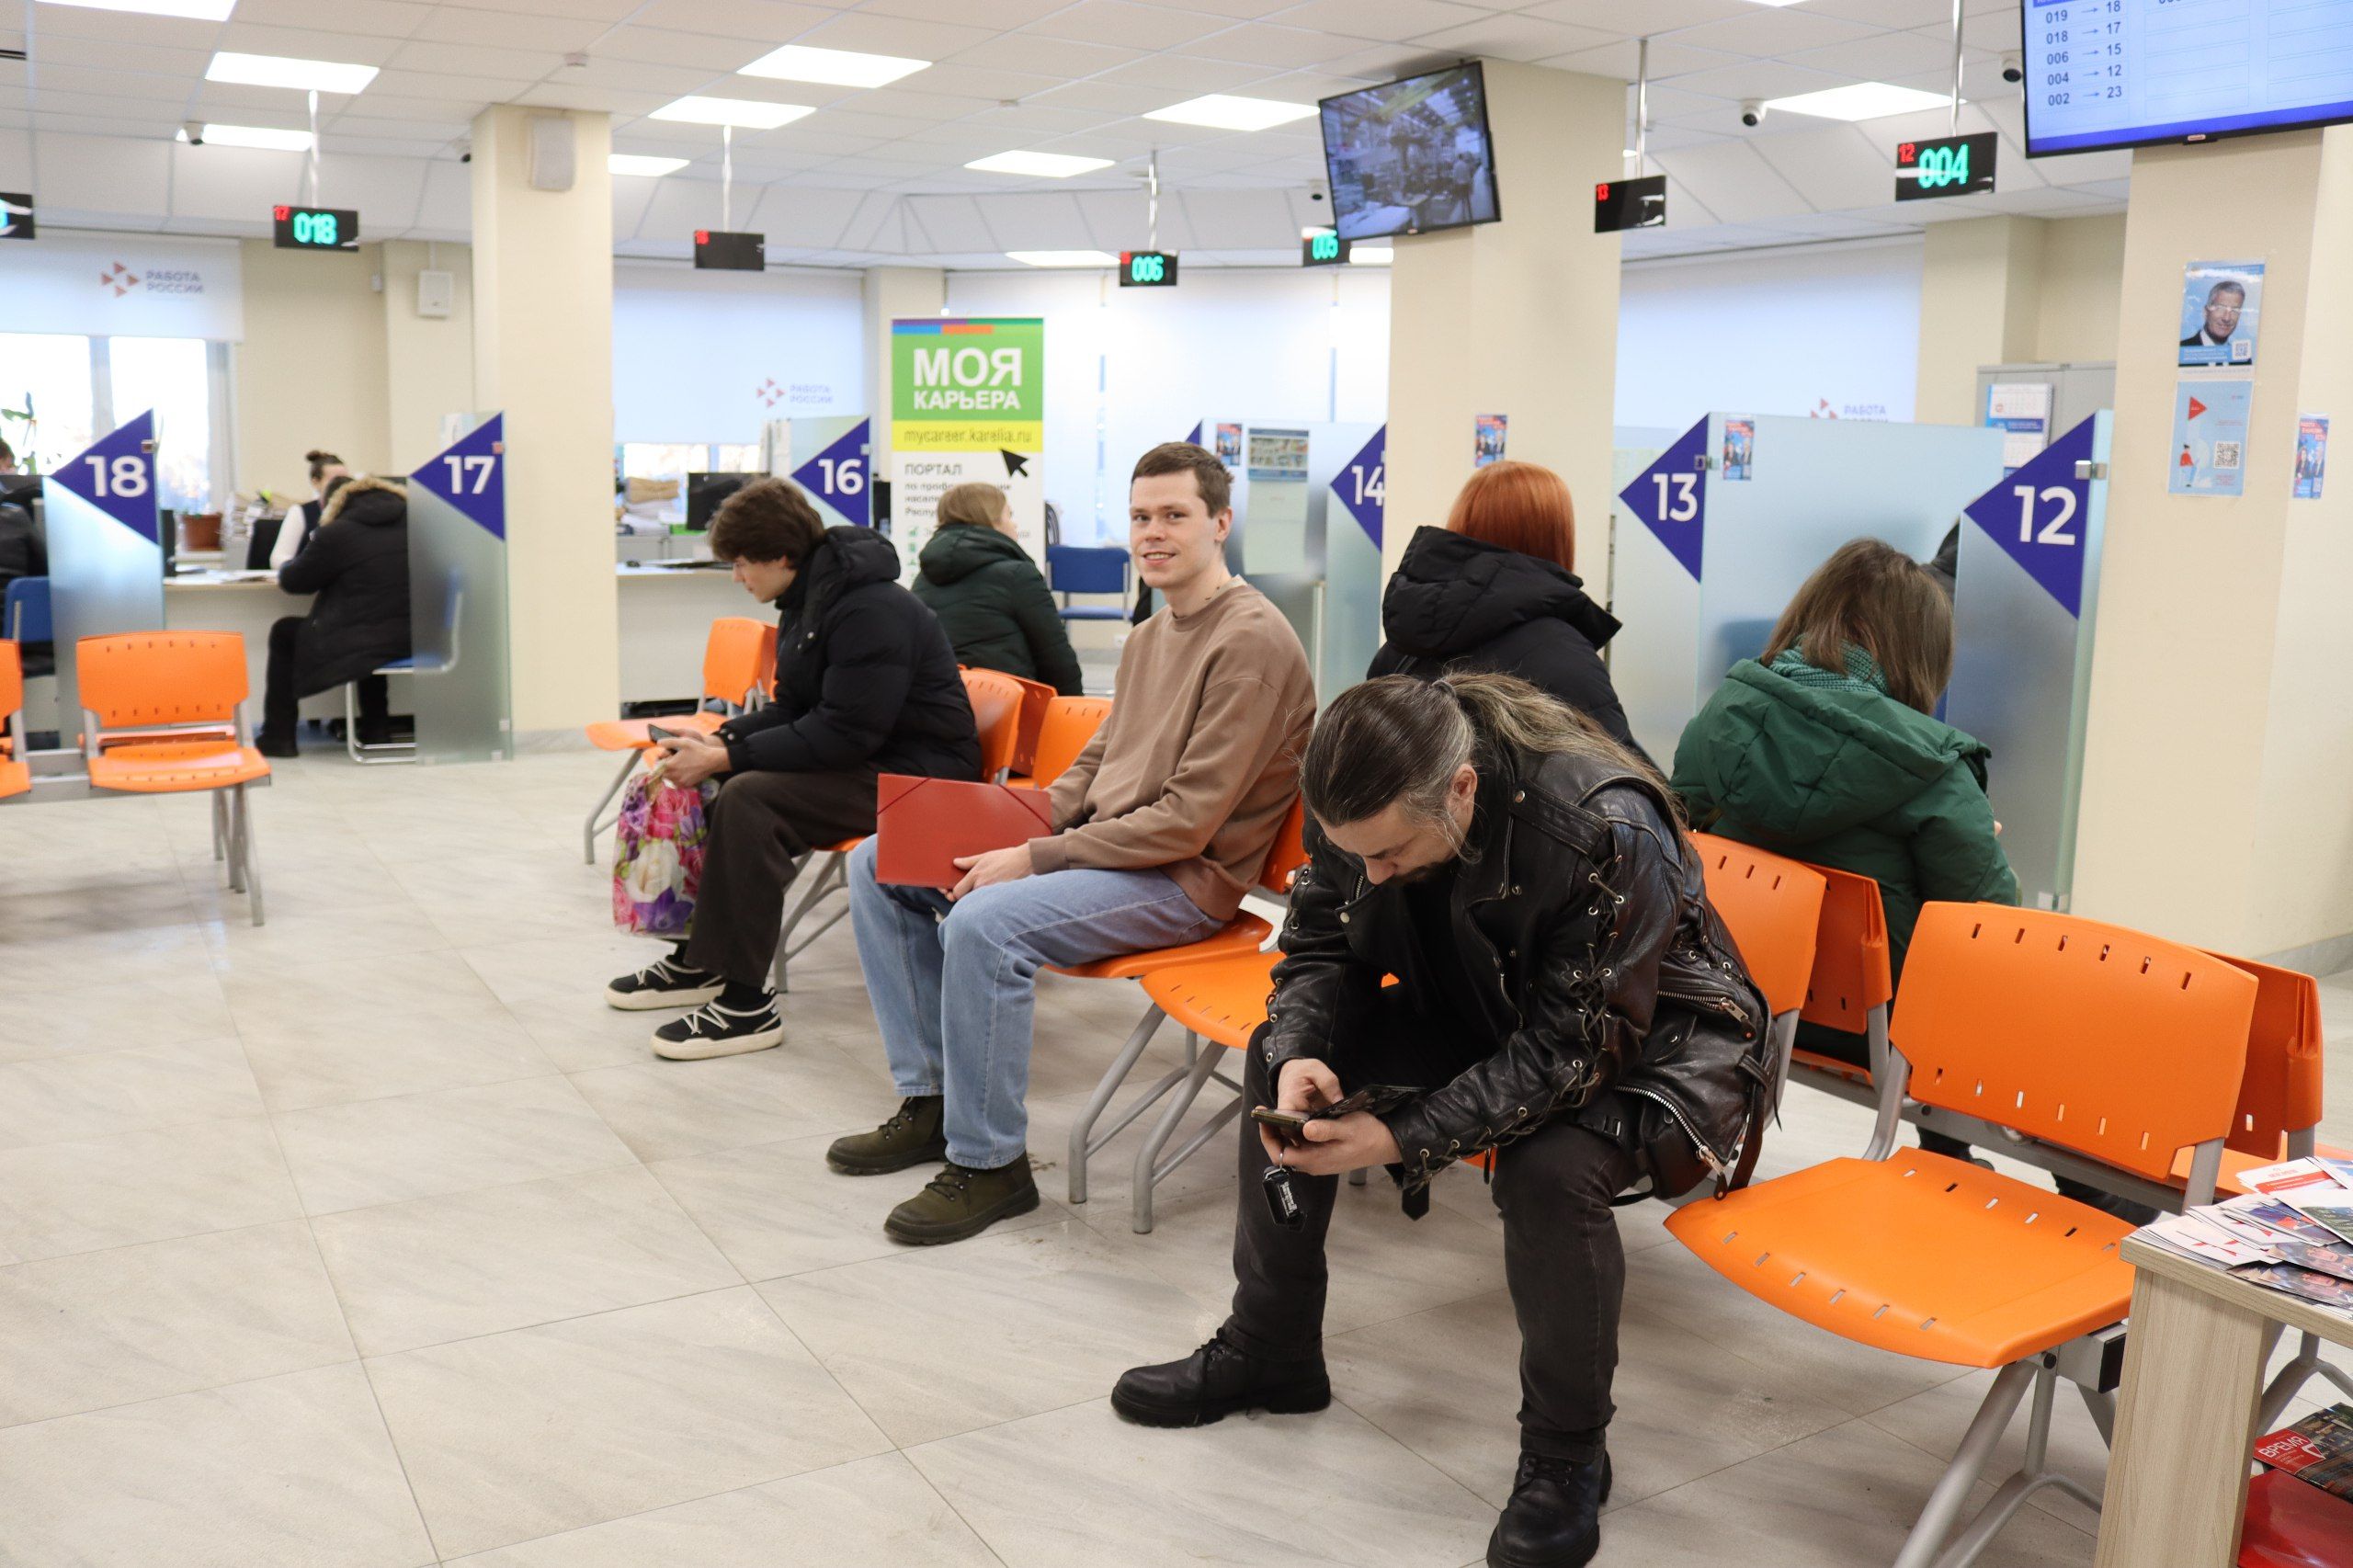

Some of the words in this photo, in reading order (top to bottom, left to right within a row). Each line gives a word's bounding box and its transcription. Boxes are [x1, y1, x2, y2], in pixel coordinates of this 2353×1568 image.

[2045, 9, 2068, 24] 019
[2107, 1, 2120, 13] 18
[2046, 30, 2068, 44] 018
[2107, 21, 2121, 34] 17
[2047, 51, 2069, 65] 006
[2108, 43, 2121, 56] 15
[2047, 72, 2069, 85] 004
[2108, 64, 2121, 77] 12
[2048, 93, 2070, 106] 002
[2108, 85, 2122, 98] 23
[1899, 142, 1915, 163] 12
[1918, 143, 1969, 188] 004
[293, 211, 337, 244] 018
[145, 270, 201, 281] РАБОТА
[1131, 256, 1164, 282] 006
[145, 282, 204, 293] РОССИИ
[913, 347, 1022, 387] МОЯ
[913, 390, 1022, 411] КАРЬЕРА
[904, 427, 1032, 444] mycareer.karelia.ru
[85, 454, 149, 498] 18
[443, 455, 495, 494] 17
[817, 458, 864, 495] 16
[904, 463, 963, 476] ПОРТАЛ
[1351, 465, 1385, 506] 14
[1652, 472, 1699, 522] 13
[2013, 485, 2077, 546] 12
